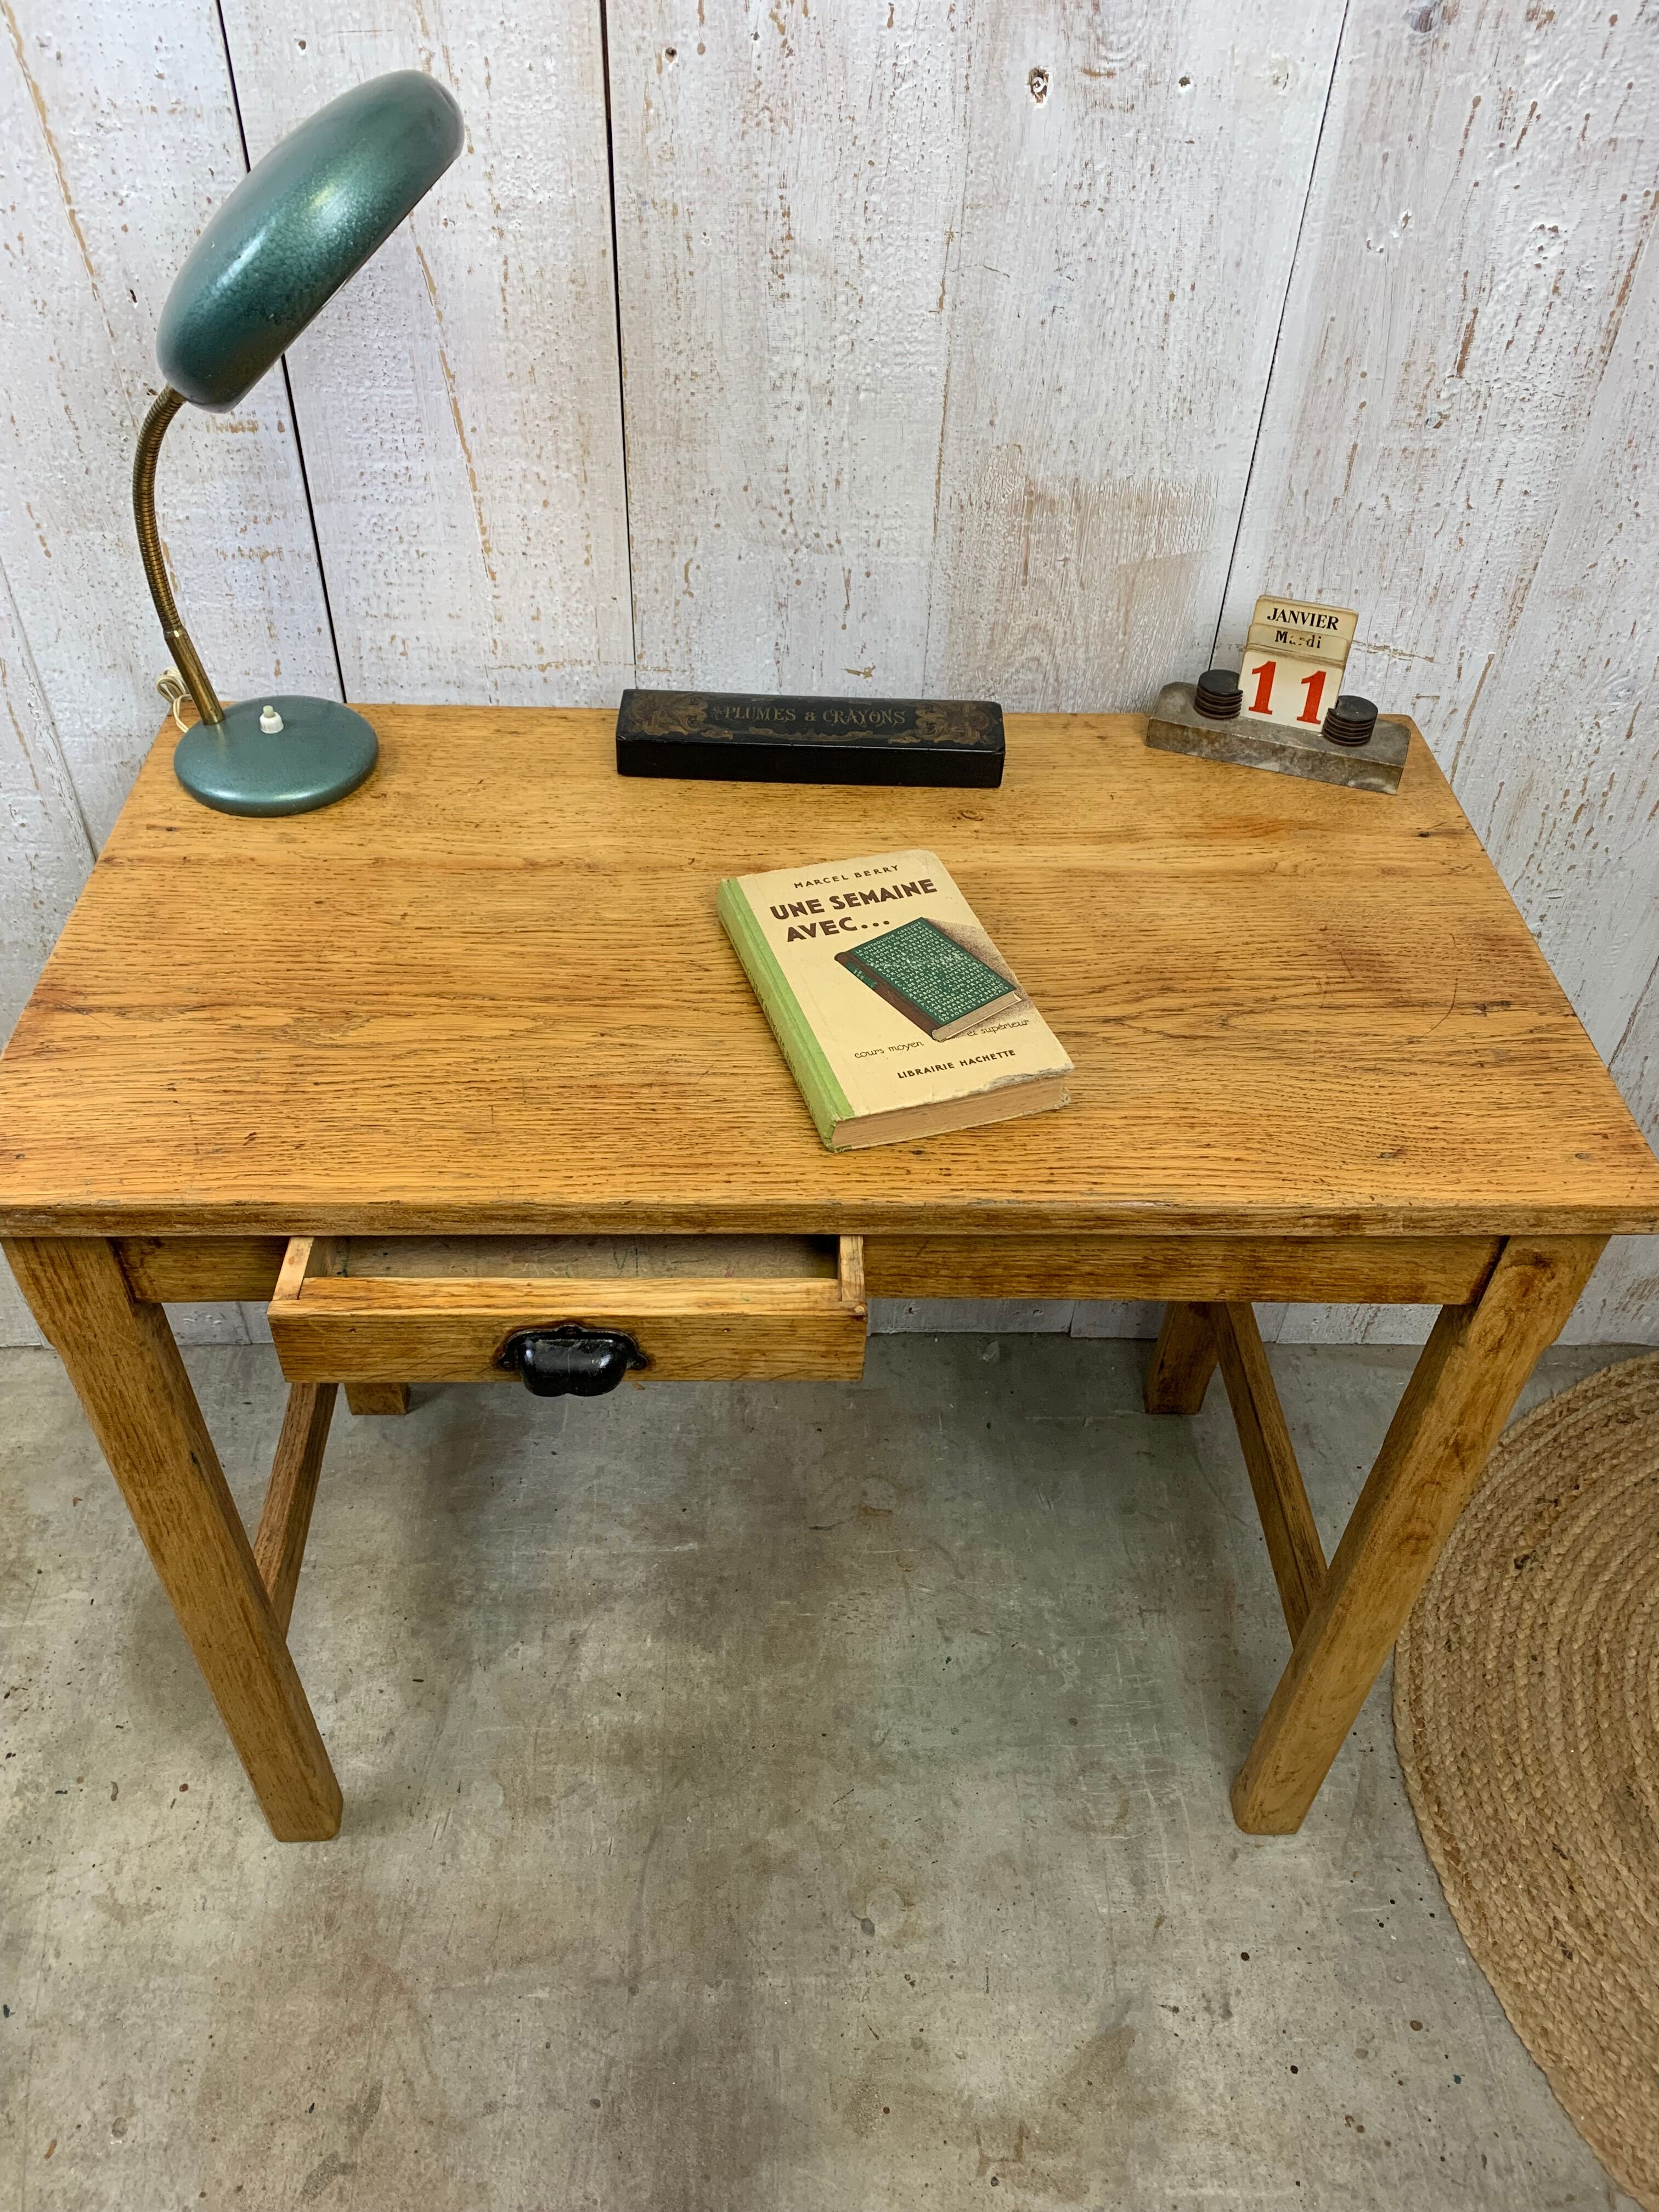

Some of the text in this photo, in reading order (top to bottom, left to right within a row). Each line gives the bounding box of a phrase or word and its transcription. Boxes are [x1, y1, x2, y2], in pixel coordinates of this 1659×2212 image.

[1267, 607, 1339, 630] JANVIER
[724, 704, 906, 725] PLUMES & CRAYONS
[794, 865, 899, 889] MARCEL BERRY
[770, 878, 938, 920] UNE SEMAINE
[787, 916, 890, 943] AVEC...
[981, 1019, 1030, 1035] supérieur
[854, 1040, 924, 1059] cours moyen
[897, 1049, 1017, 1079] LIBRAIRIE HACHETTE
